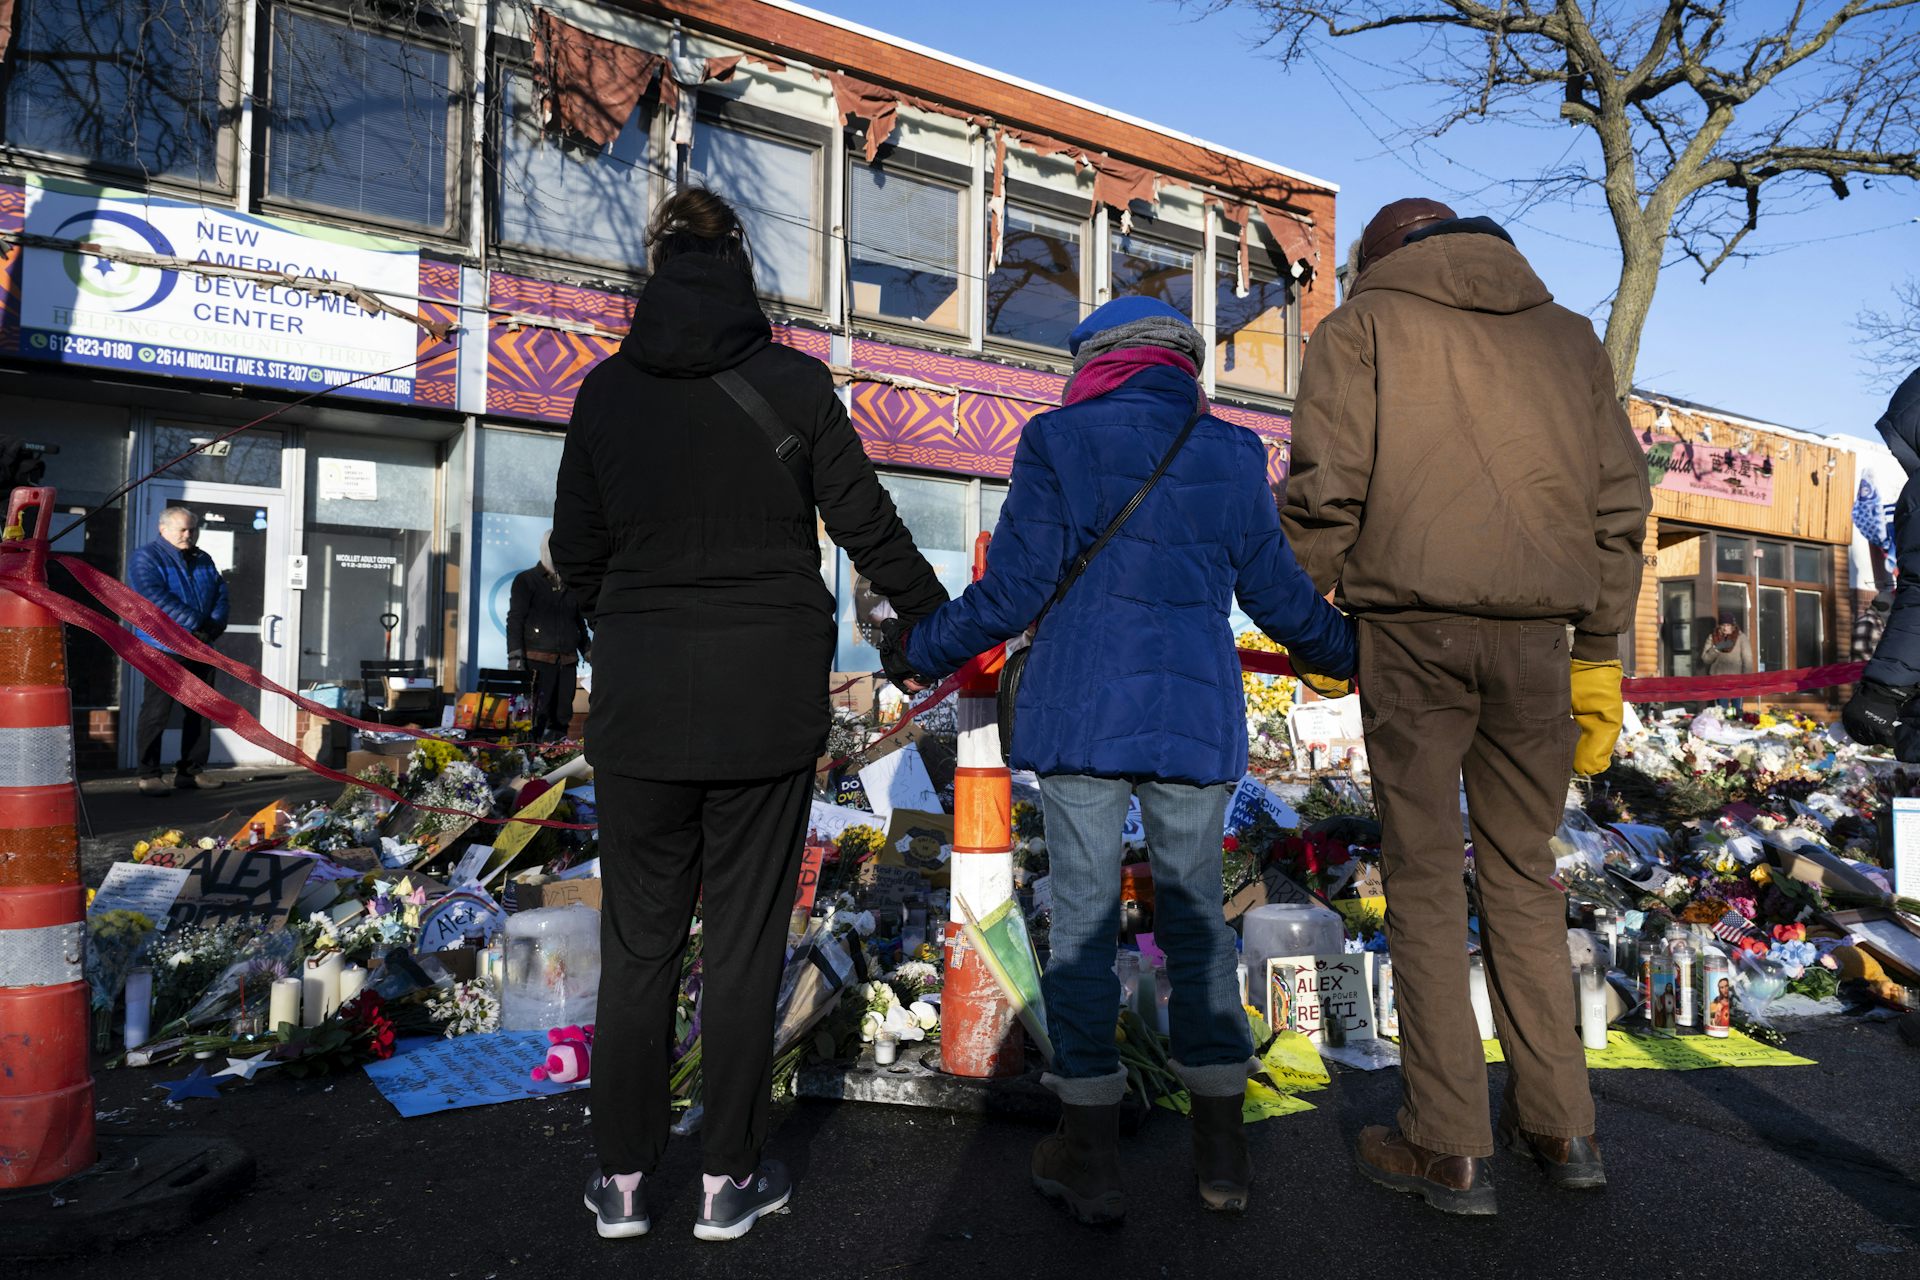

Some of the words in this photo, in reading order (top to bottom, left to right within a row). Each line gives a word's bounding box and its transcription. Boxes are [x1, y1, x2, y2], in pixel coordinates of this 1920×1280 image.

[197, 221, 259, 247] NEW
[197, 249, 338, 282] AMERICAN
[194, 303, 304, 334] CENTER
[53, 309, 159, 337] HELPING
[168, 325, 306, 355] COMMUNITY
[319, 346, 392, 369] THRIVE
[50, 334, 133, 361] 612-823-0180
[156, 348, 185, 367] 2614
[187, 351, 235, 374] NICOLLET
[236, 358, 256, 376] AVE
[257, 360, 267, 377] S.
[268, 363, 287, 379] STE
[288, 365, 308, 382] 207
[324, 369, 411, 395] WWW.NADCMN.ORG
[336, 554, 360, 562] NICOLLET
[361, 555, 376, 563] ADULT
[1241, 781, 1261, 798] ICE
[1261, 798, 1282, 817] OUT
[182, 848, 313, 902] ALEX
[437, 907, 477, 940] Alex
[1297, 975, 1343, 994] ALEX
[1332, 991, 1358, 999] POWER
[1297, 1001, 1357, 1022] RETI
